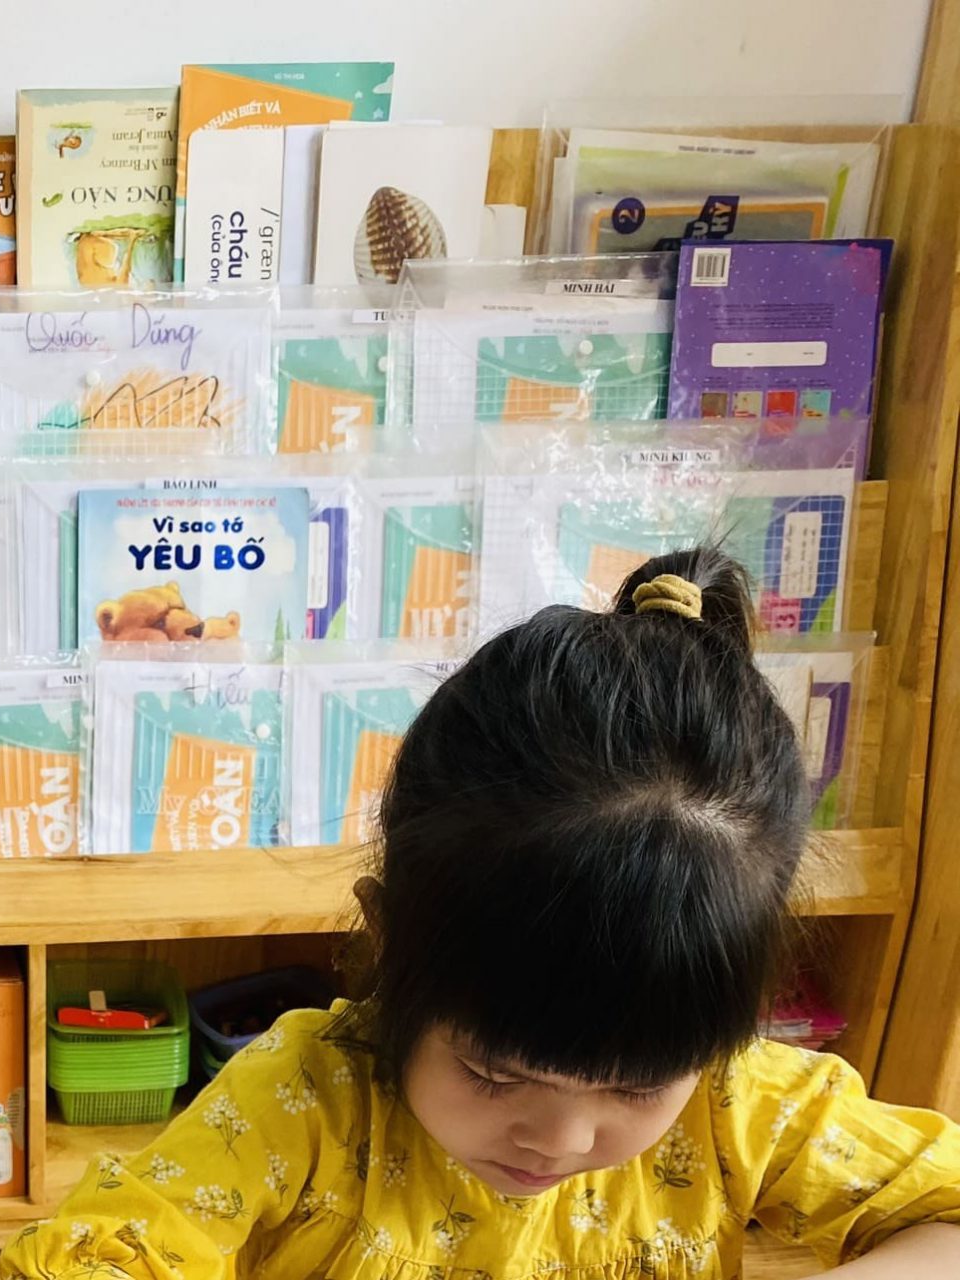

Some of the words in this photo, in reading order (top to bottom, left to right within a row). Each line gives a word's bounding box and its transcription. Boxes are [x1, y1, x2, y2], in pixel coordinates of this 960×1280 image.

[71, 187, 118, 209] NÀO
[227, 211, 250, 279] cháu
[563, 284, 591, 293] MINH
[190, 480, 217, 489] LINH
[153, 516, 174, 533] Vì
[179, 521, 216, 533] sao
[221, 516, 244, 533] tớ
[128, 537, 202, 571] YÊU
[213, 536, 265, 571] BỐ
[202, 760, 244, 846] OÁN
